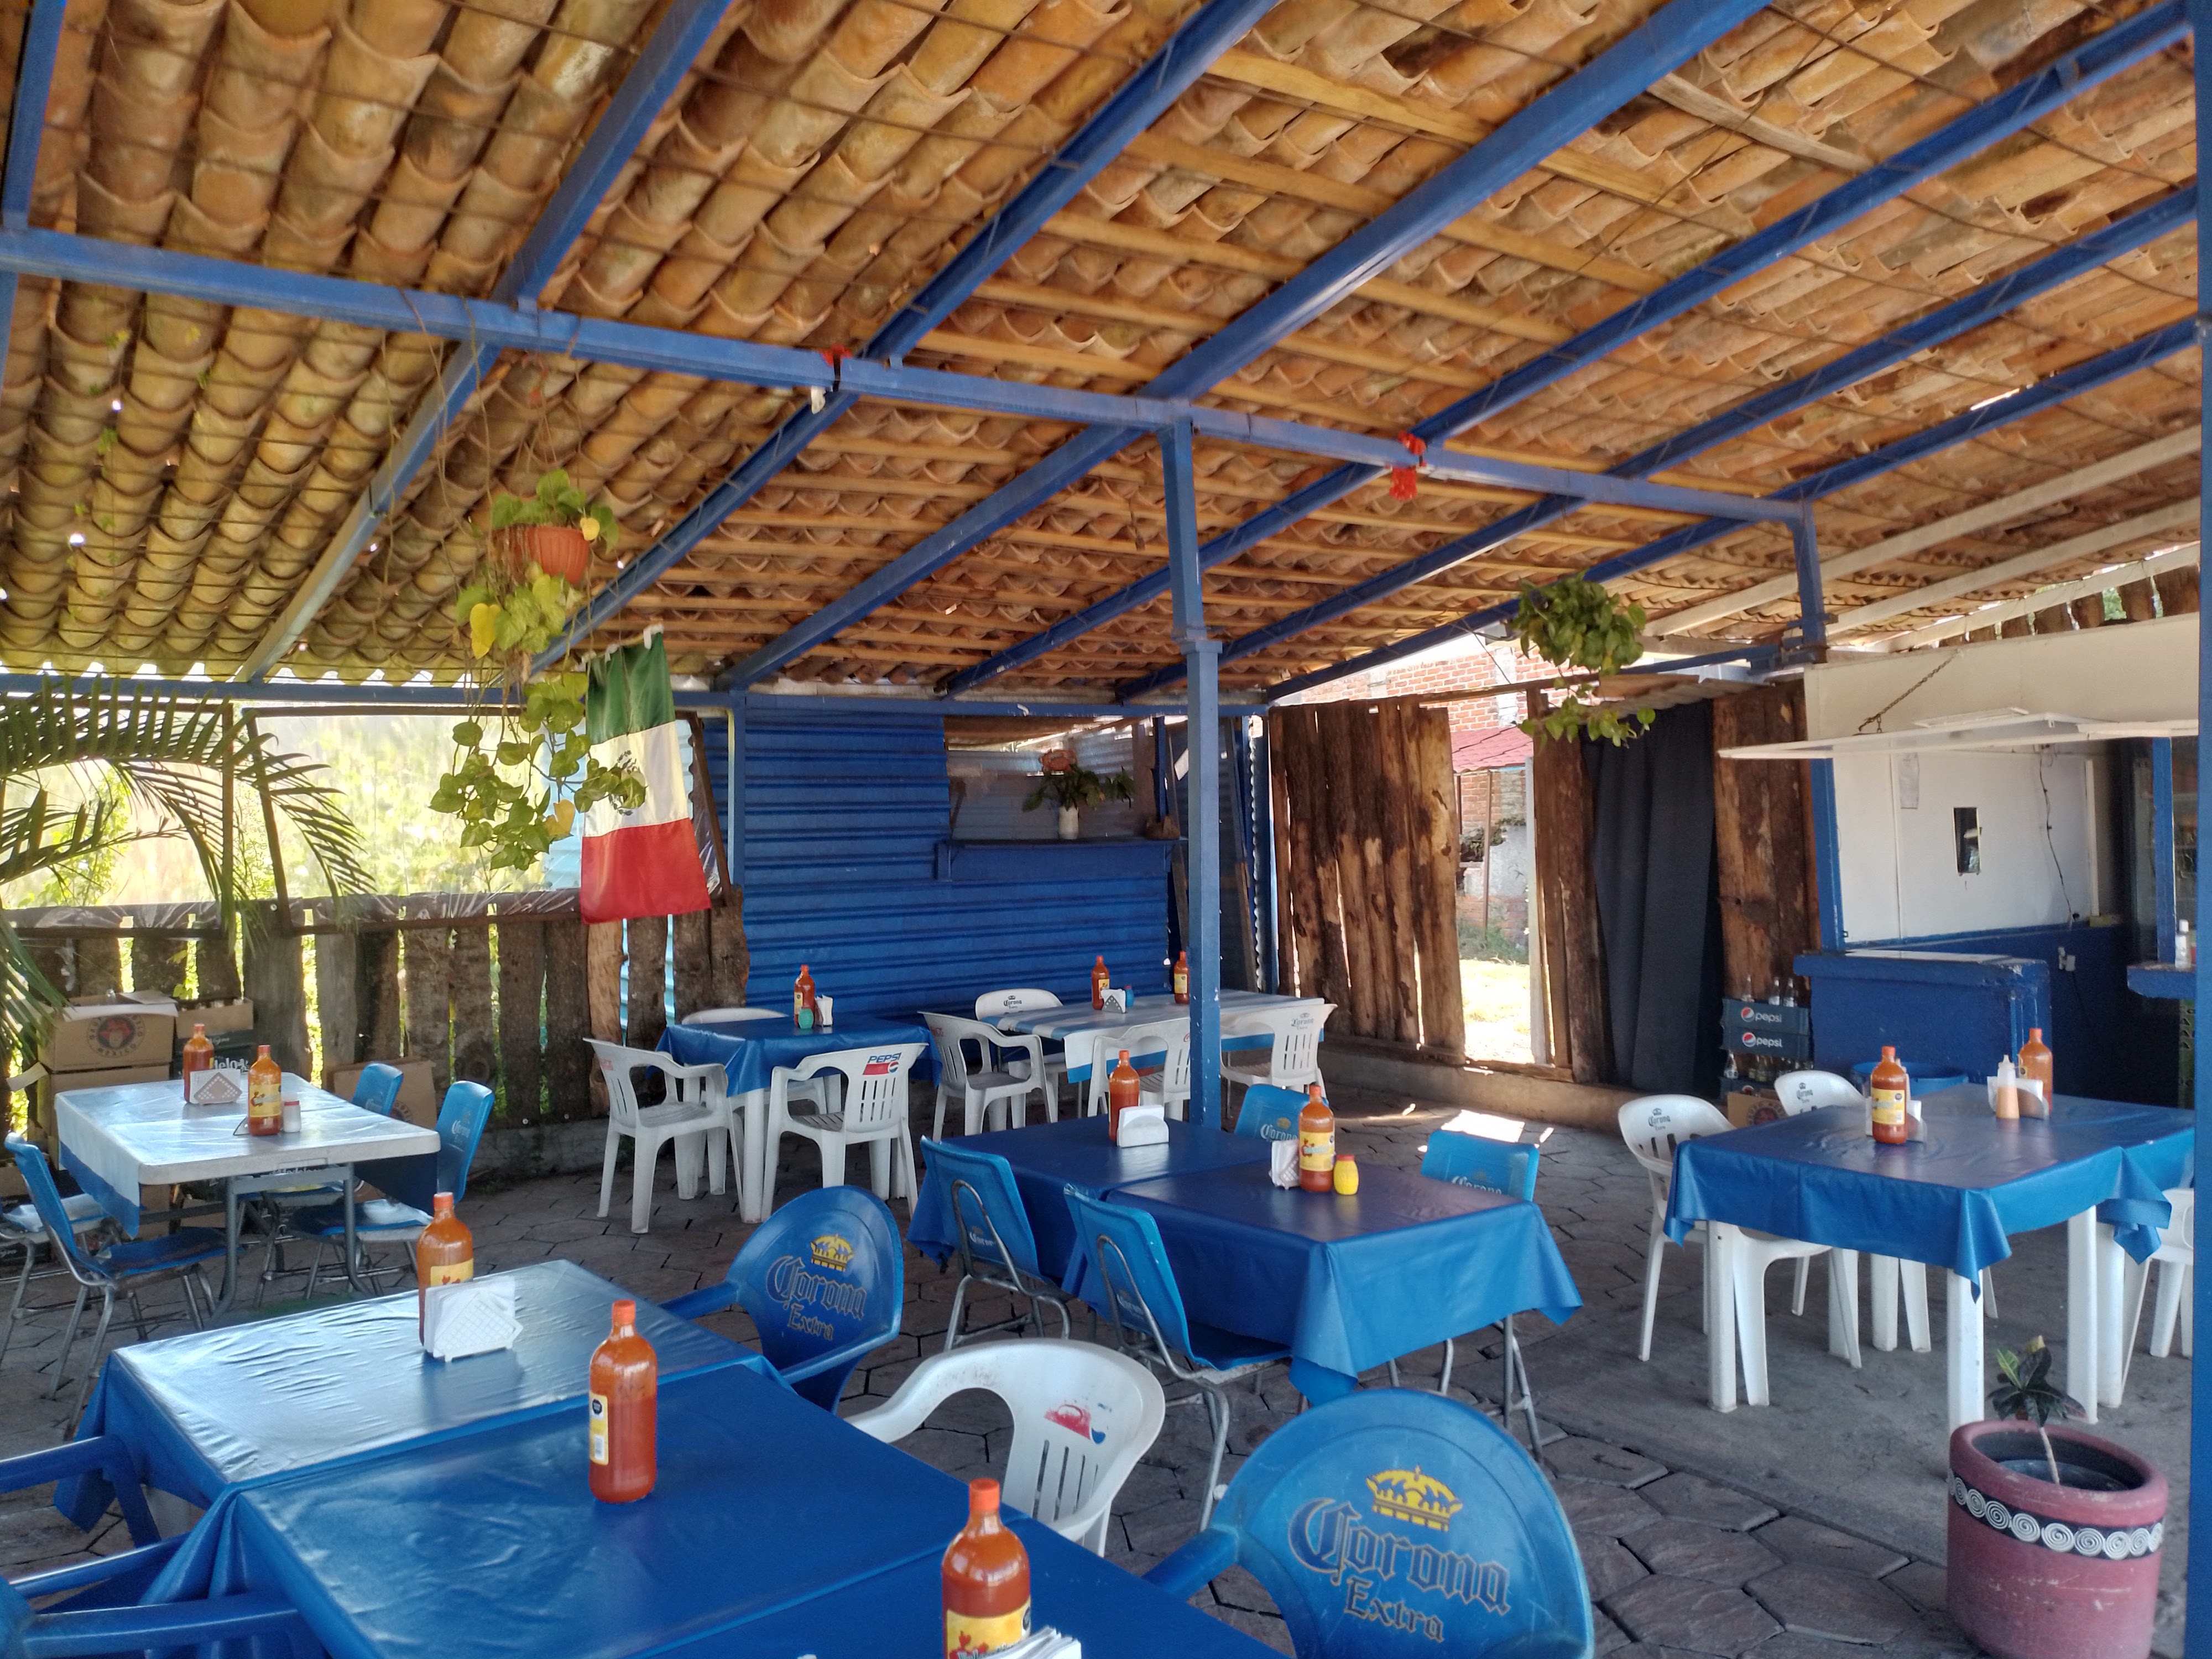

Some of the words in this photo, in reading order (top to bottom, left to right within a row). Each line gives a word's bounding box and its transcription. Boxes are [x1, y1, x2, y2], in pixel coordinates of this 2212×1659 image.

[1755, 1013, 1782, 1023] pepsi
[1756, 1037, 1783, 1048] pepsi
[867, 1052, 902, 1063] PEPSI
[1648, 1116, 1671, 1127] Corona
[765, 1255, 867, 1321] Corona
[787, 1302, 833, 1341] Extra
[1287, 1498, 1511, 1616] Corona
[1343, 1575, 1444, 1643] Extra
